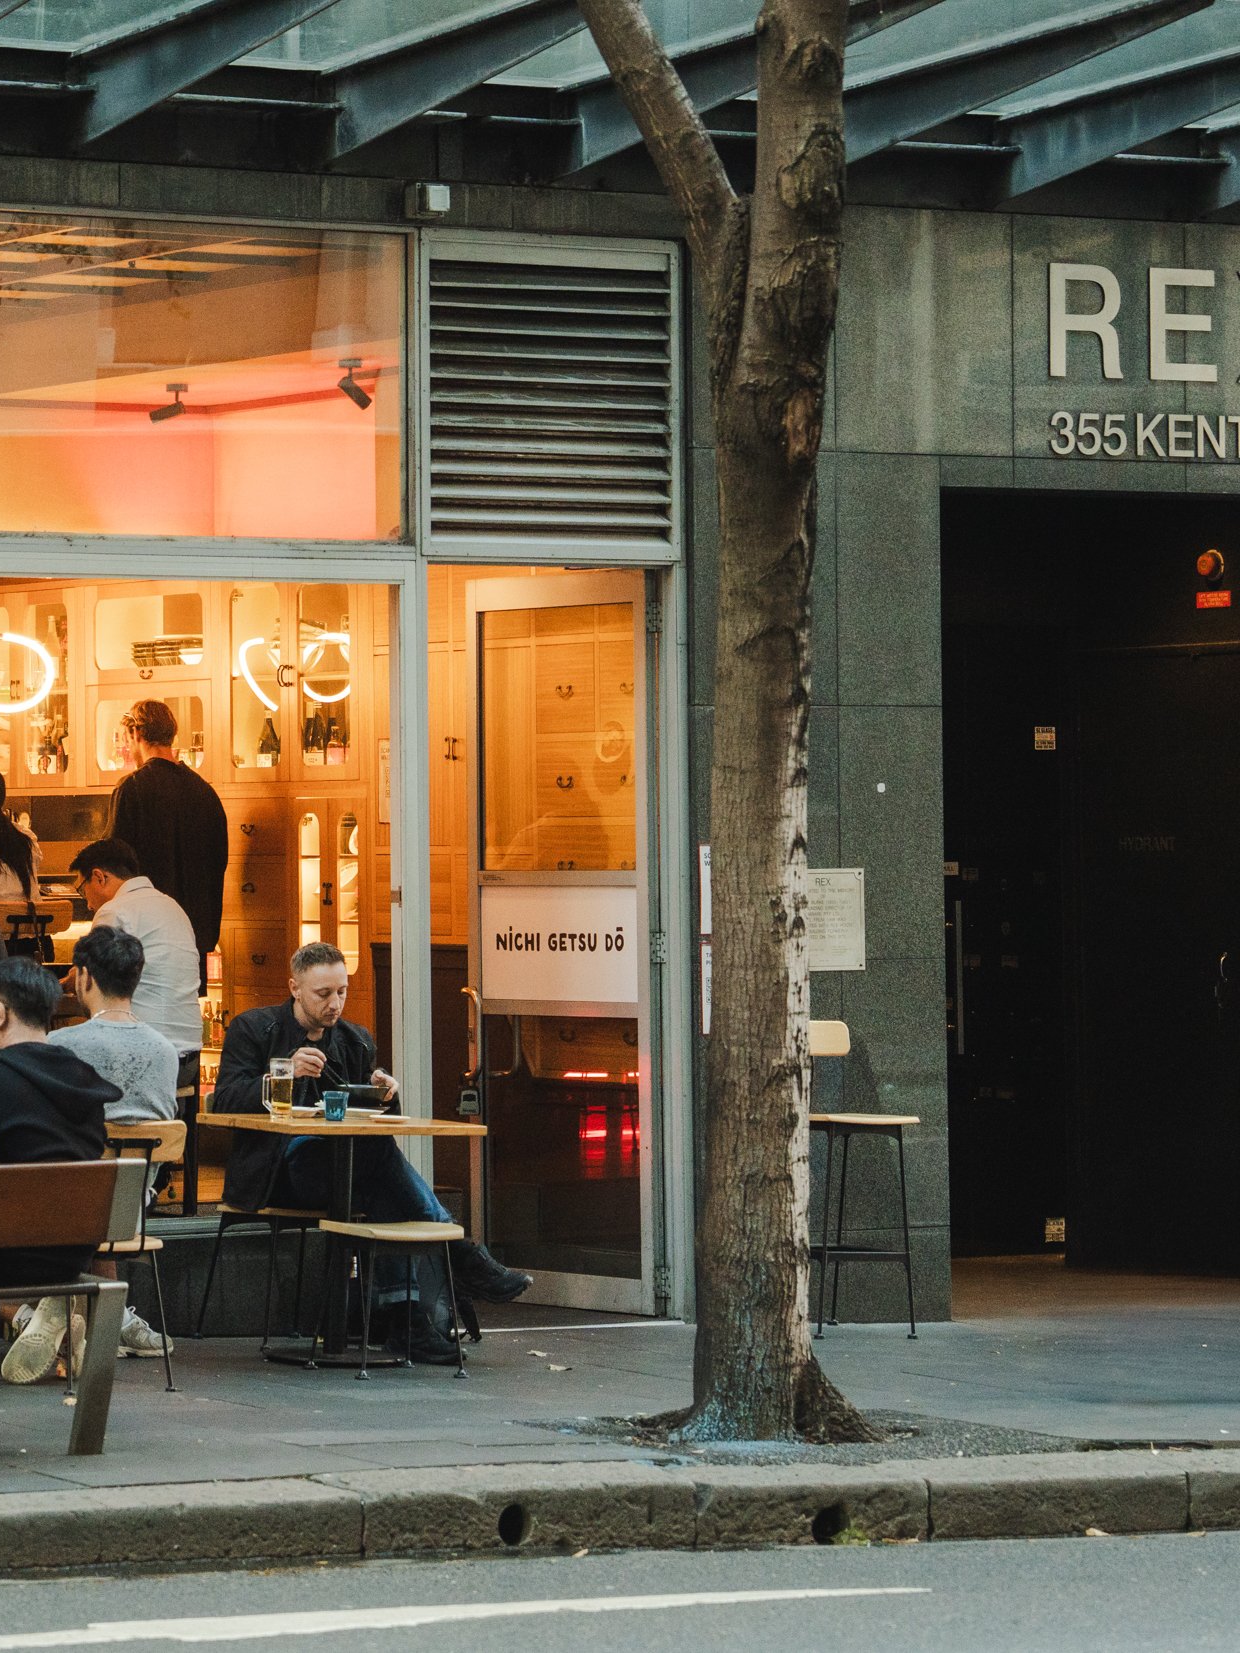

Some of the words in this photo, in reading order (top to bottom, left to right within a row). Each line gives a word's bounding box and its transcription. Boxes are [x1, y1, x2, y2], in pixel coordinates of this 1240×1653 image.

[1049, 262, 1240, 382] RE
[1050, 410, 1128, 456] 355
[1118, 836, 1176, 851] HYDRANT
[815, 877, 831, 886] REX
[548, 932, 598, 952] GETSU
[605, 926, 625, 952] DŌ
